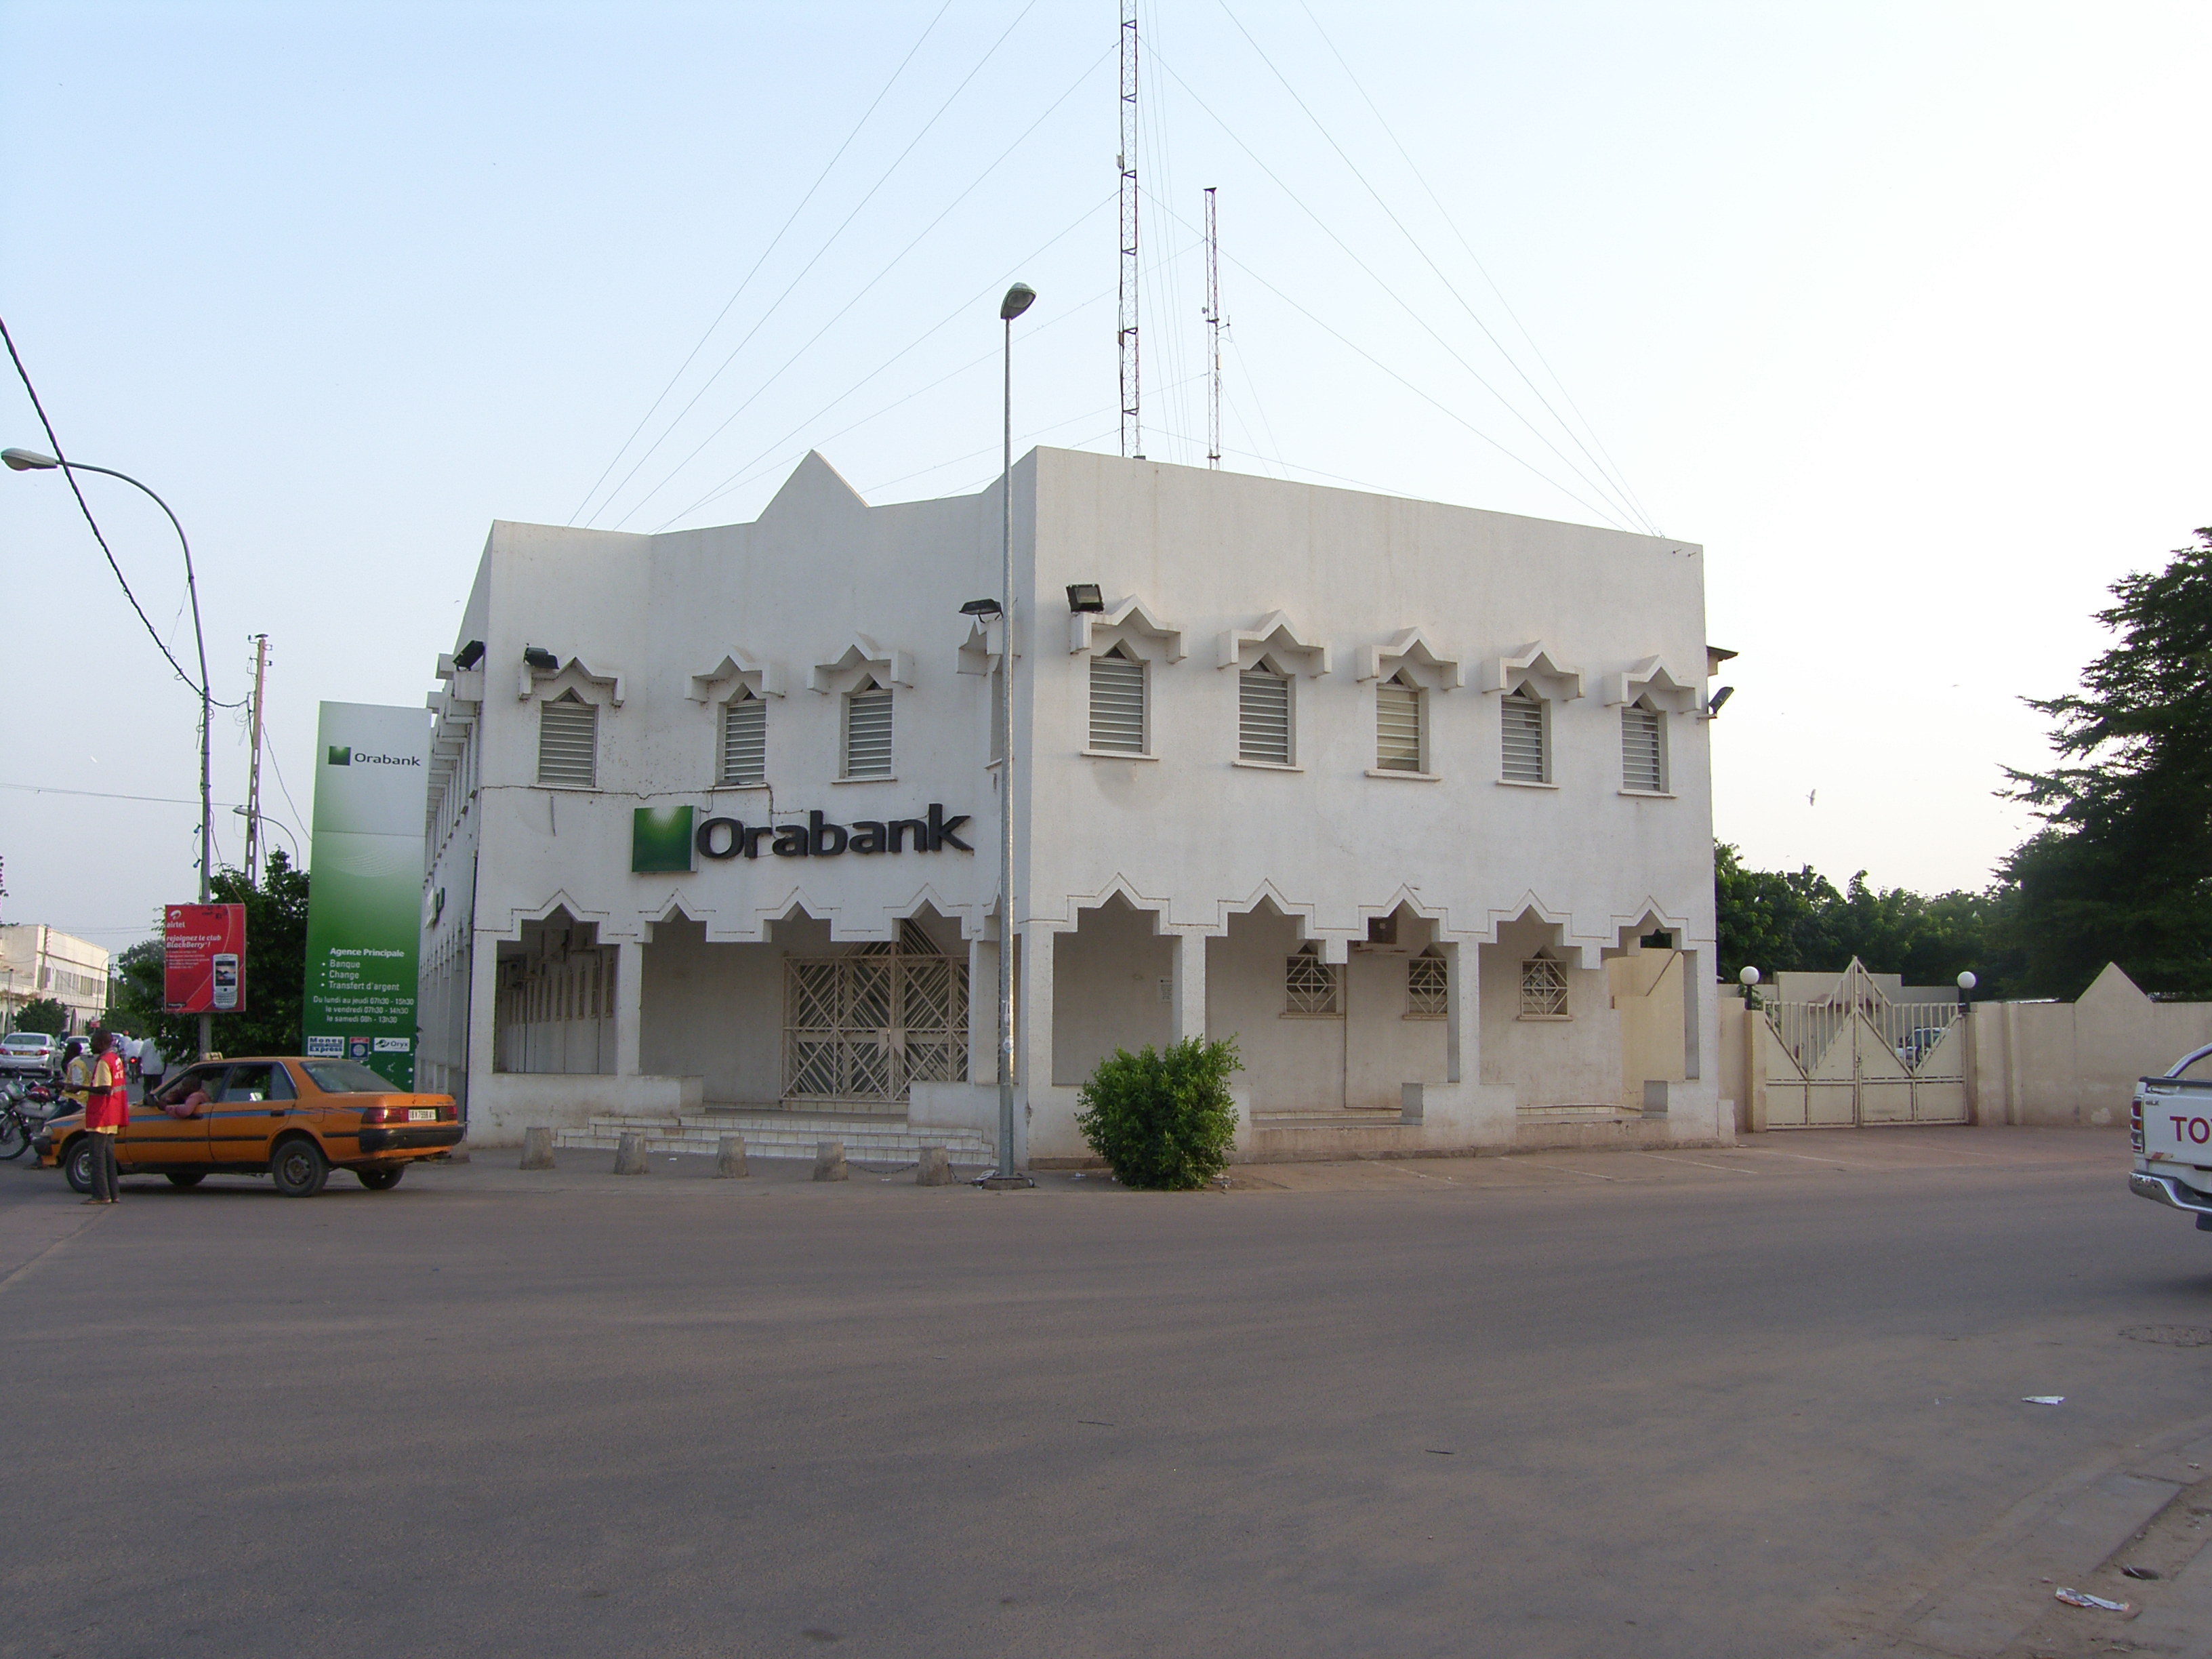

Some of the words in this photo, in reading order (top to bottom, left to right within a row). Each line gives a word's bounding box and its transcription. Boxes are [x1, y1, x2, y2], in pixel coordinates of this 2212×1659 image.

[354, 753, 421, 766] Orabank
[696, 803, 975, 859] Orabank
[167, 935, 198, 943] rejoignez
[330, 947, 362, 957] Agence
[363, 949, 405, 958] Principale
[329, 960, 361, 968] Banque
[329, 970, 360, 980] Change
[329, 981, 365, 990] Transfert
[366, 982, 400, 992] d'argent
[324, 996, 341, 1004] lundi
[352, 997, 369, 1005] jeudi
[370, 997, 389, 1005] 07h30
[390, 1040, 408, 1048] Oryx
